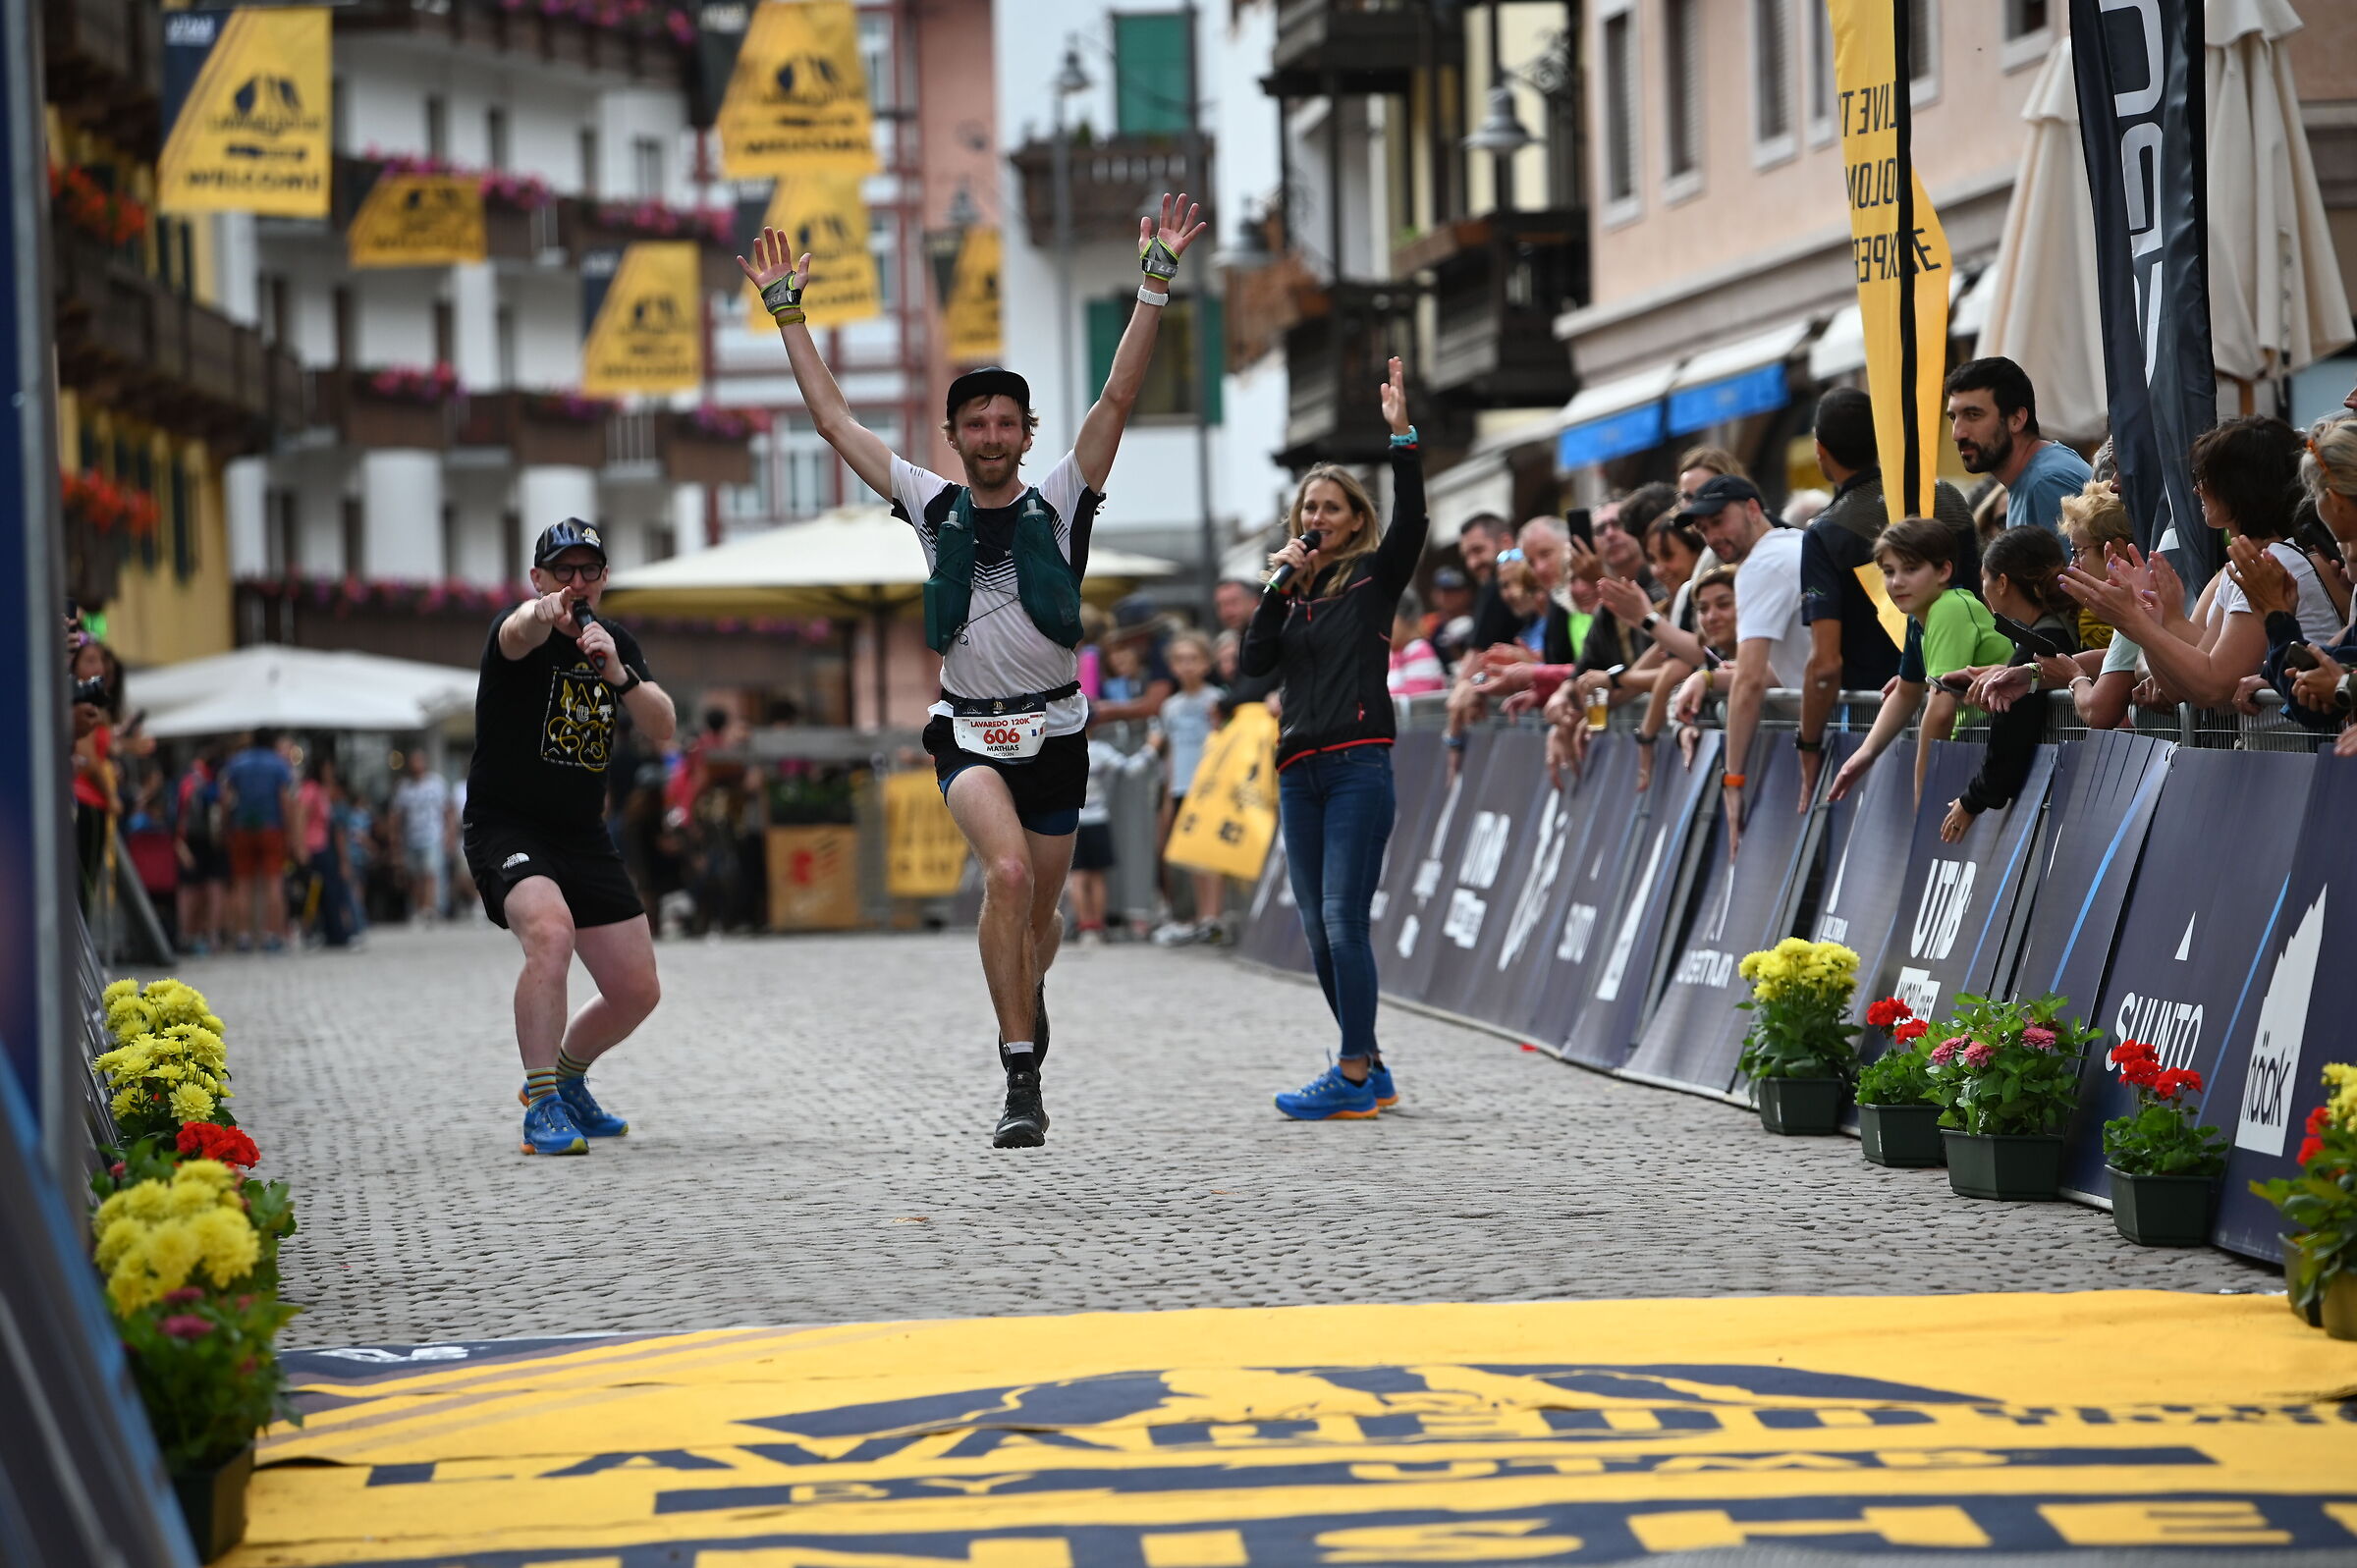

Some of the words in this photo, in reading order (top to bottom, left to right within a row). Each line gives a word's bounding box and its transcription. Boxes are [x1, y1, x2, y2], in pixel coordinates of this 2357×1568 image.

[970, 719, 1009, 728] LAVAREDO
[1011, 717, 1030, 727] 120K
[983, 728, 1020, 744] 606
[1911, 858, 1977, 961] UTMB
